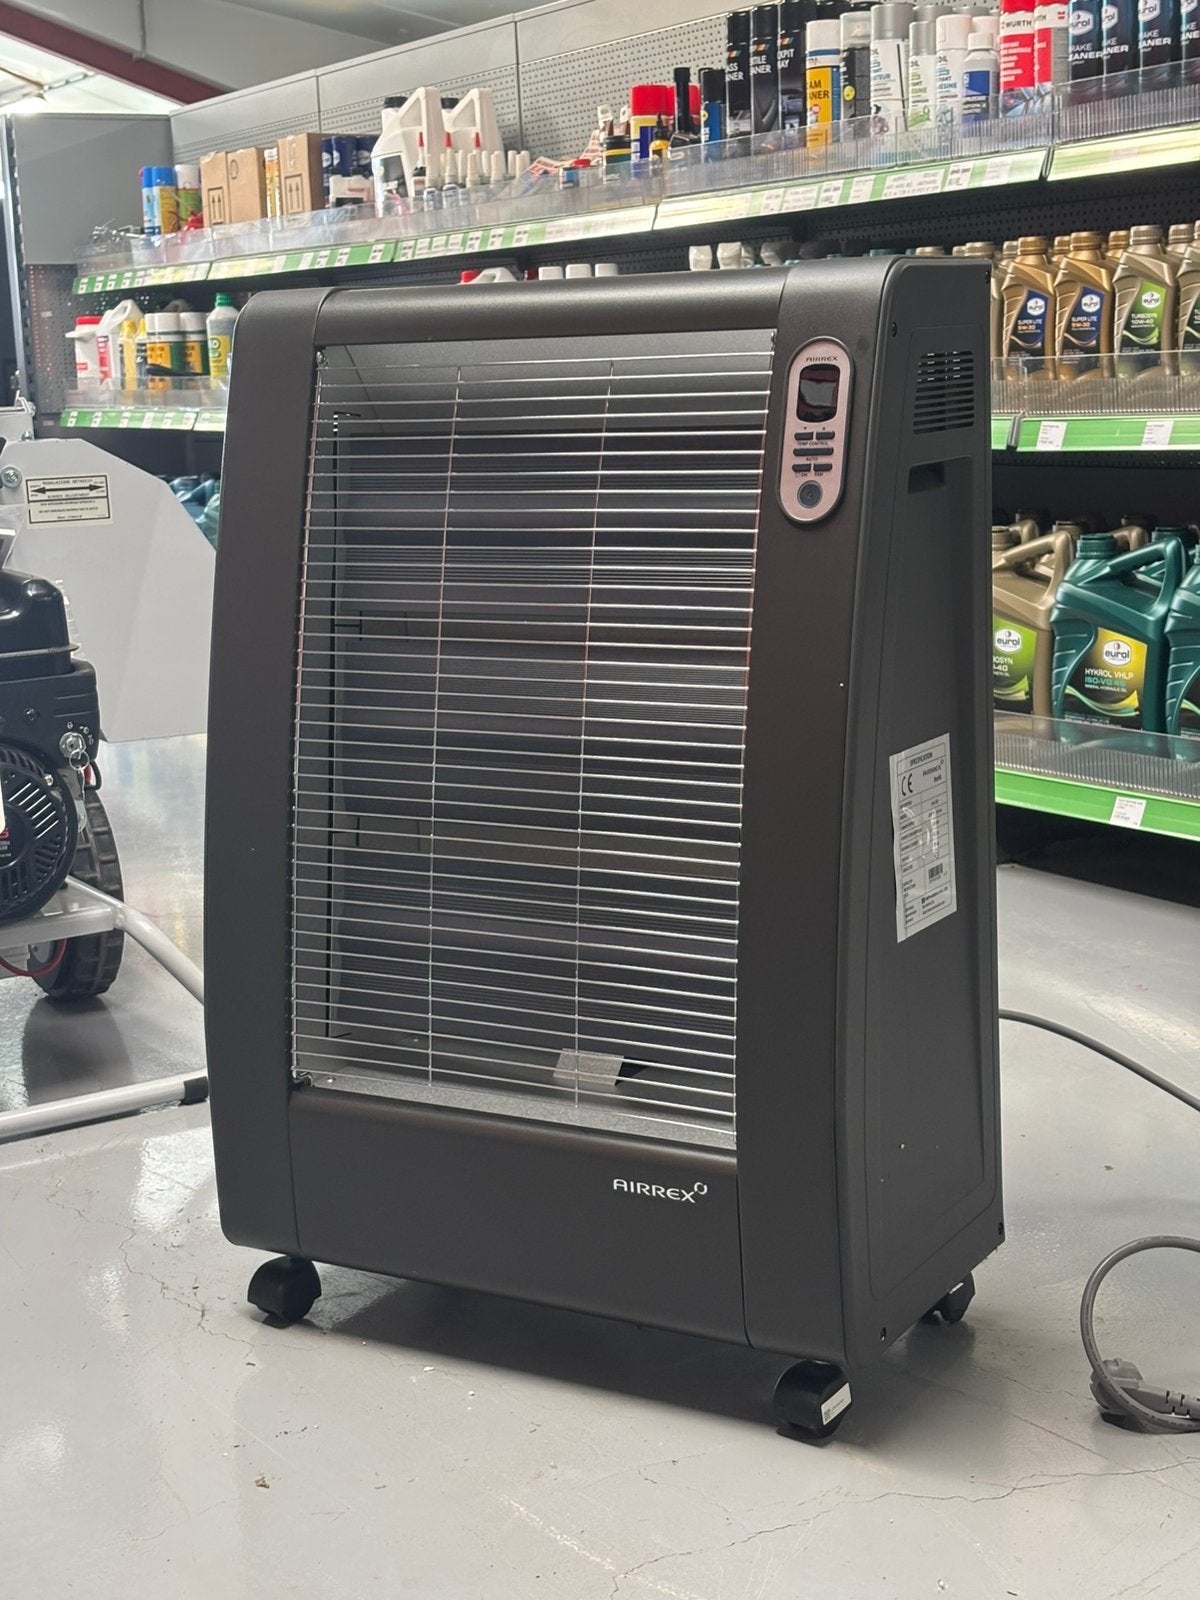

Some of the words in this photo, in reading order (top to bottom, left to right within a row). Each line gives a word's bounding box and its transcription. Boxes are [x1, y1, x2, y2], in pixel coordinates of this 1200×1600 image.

[996, 637, 1020, 646] eurol
[1105, 650, 1130, 659] eurol
[613, 1178, 697, 1204] AIRREX
